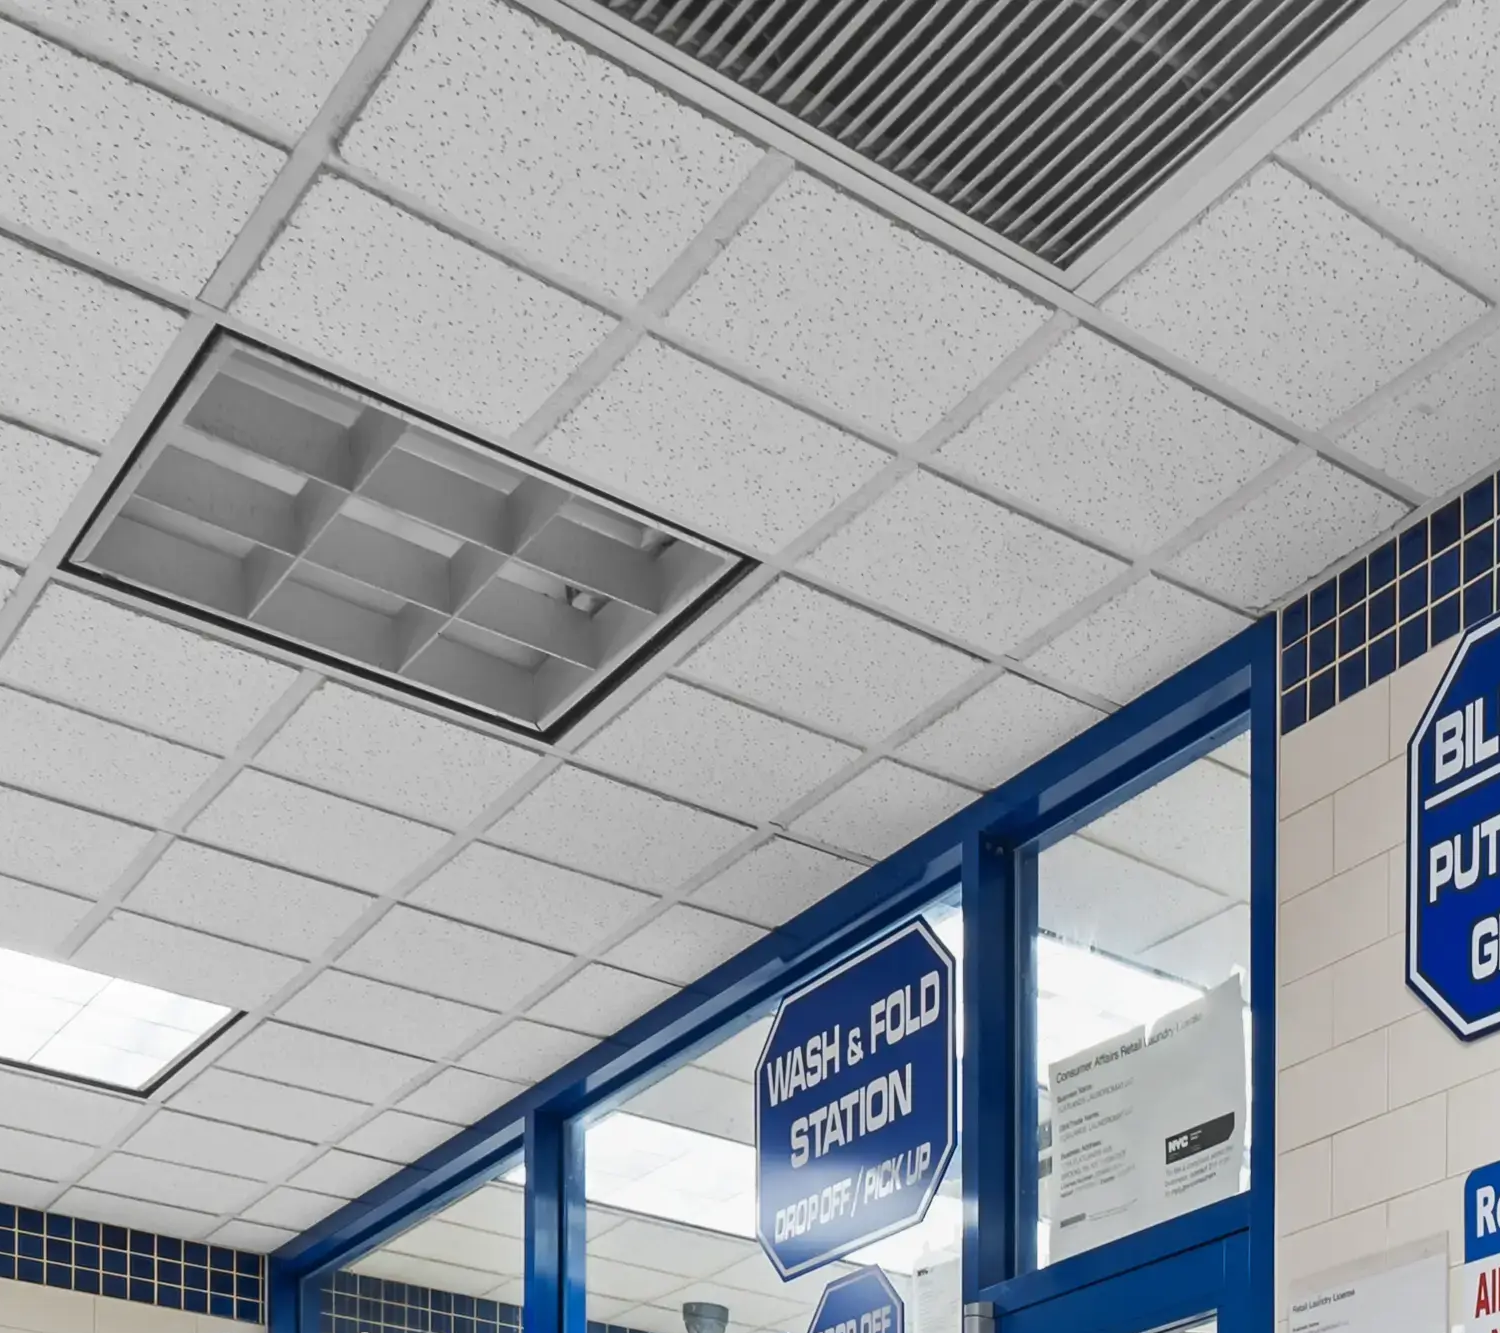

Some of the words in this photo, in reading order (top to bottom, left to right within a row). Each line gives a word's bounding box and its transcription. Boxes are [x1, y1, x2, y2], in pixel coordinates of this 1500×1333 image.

[767, 1024, 840, 1107] WASH
[847, 1026, 864, 1066] &
[870, 970, 940, 1055] FOLD
[790, 1062, 912, 1170] STATION
[774, 1194, 818, 1244] DROP
[819, 1177, 852, 1225] OFF
[864, 1152, 904, 1205] PICK
[905, 1141, 930, 1187] UP
